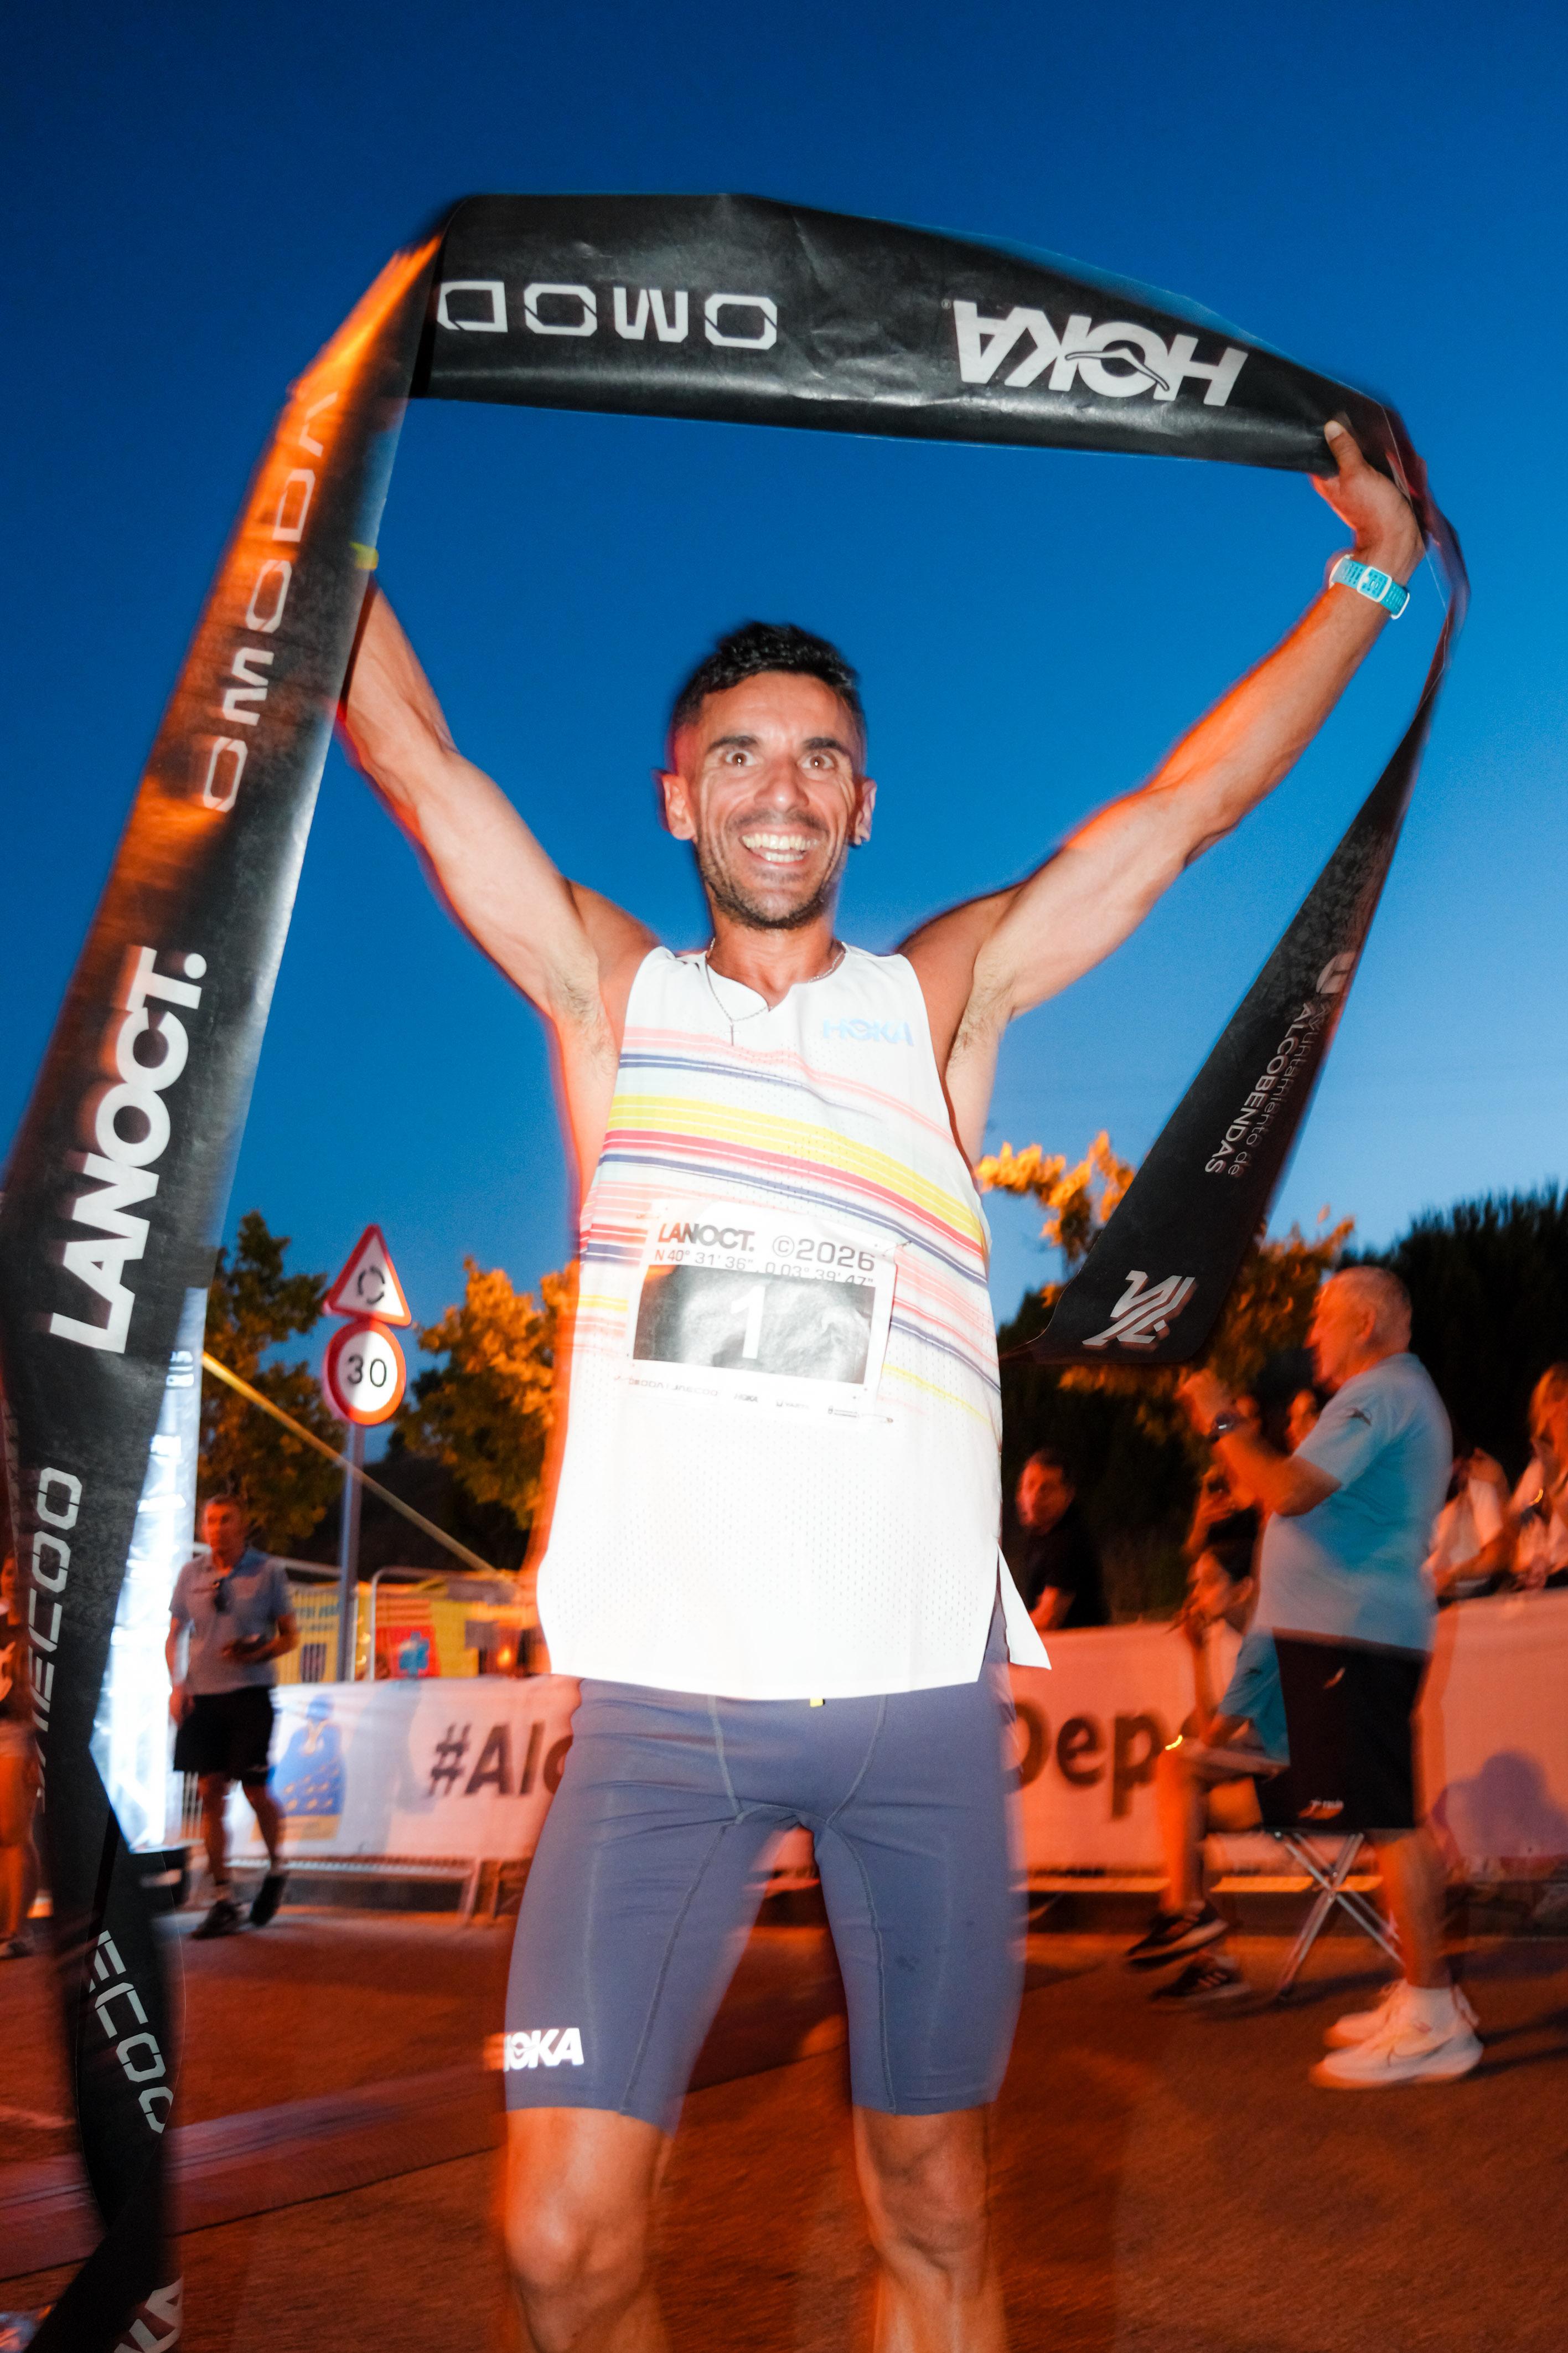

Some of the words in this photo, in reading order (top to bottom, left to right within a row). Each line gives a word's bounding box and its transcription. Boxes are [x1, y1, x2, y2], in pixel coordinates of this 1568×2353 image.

[953, 300, 1248, 406] HOKA
[203, 391, 339, 813] OMODA
[823, 1018, 914, 1047] HOKA
[1205, 1003, 1313, 1173] ALCOBENDAS
[50, 945, 207, 1353] LANOCT.
[1228, 1151, 1249, 1176] de
[655, 1249, 665, 1261] N
[667, 1250, 690, 1262] 40°
[658, 1222, 755, 1252] LANOCT.
[731, 1284, 766, 1360] 1
[348, 1354, 387, 1387] 30
[28, 1467, 82, 1813] ECOO
